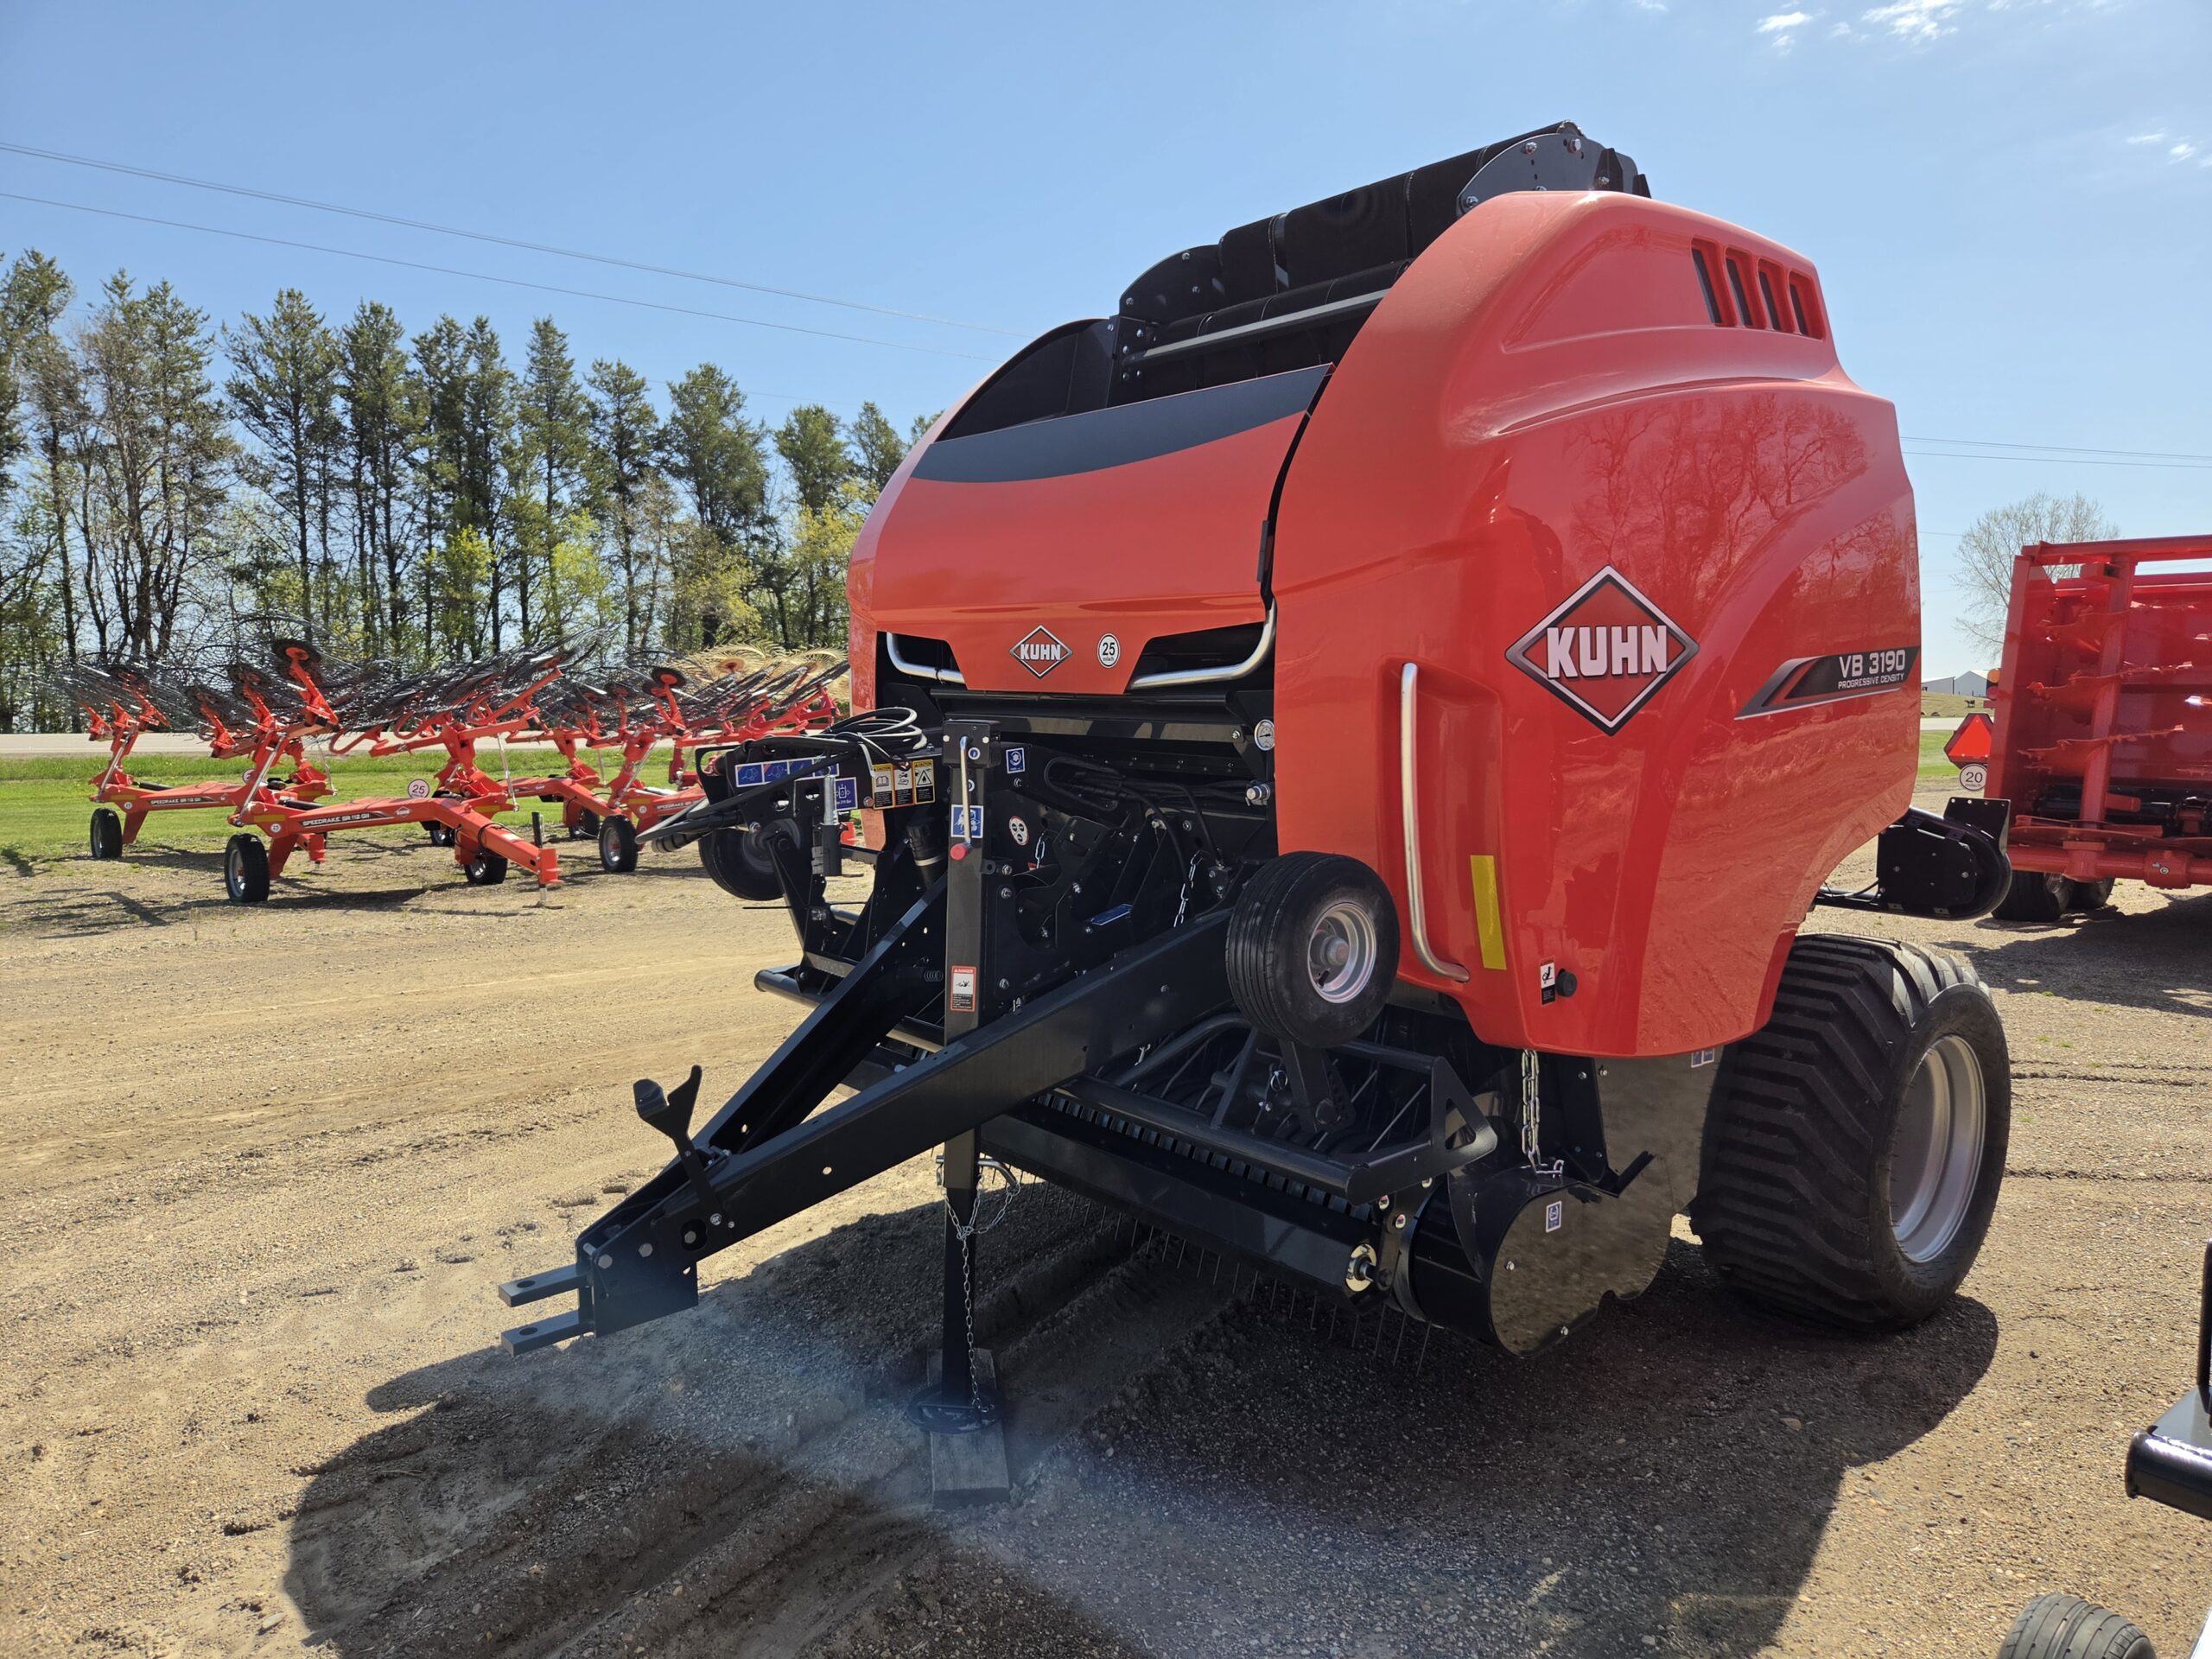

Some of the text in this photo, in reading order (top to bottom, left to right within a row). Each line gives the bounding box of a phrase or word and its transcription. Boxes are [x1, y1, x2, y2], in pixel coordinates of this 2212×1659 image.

[1020, 644, 1061, 660] KUHN
[1103, 642, 1116, 656] 25
[1547, 625, 1668, 678] KUHN
[1839, 649, 1905, 678] VB 3190
[1838, 673, 1904, 689] PROGRESSIVE DENSITY
[1966, 772, 1983, 783] 20
[412, 785, 425, 794] 25
[302, 817, 340, 826] SPEEDRAKE
